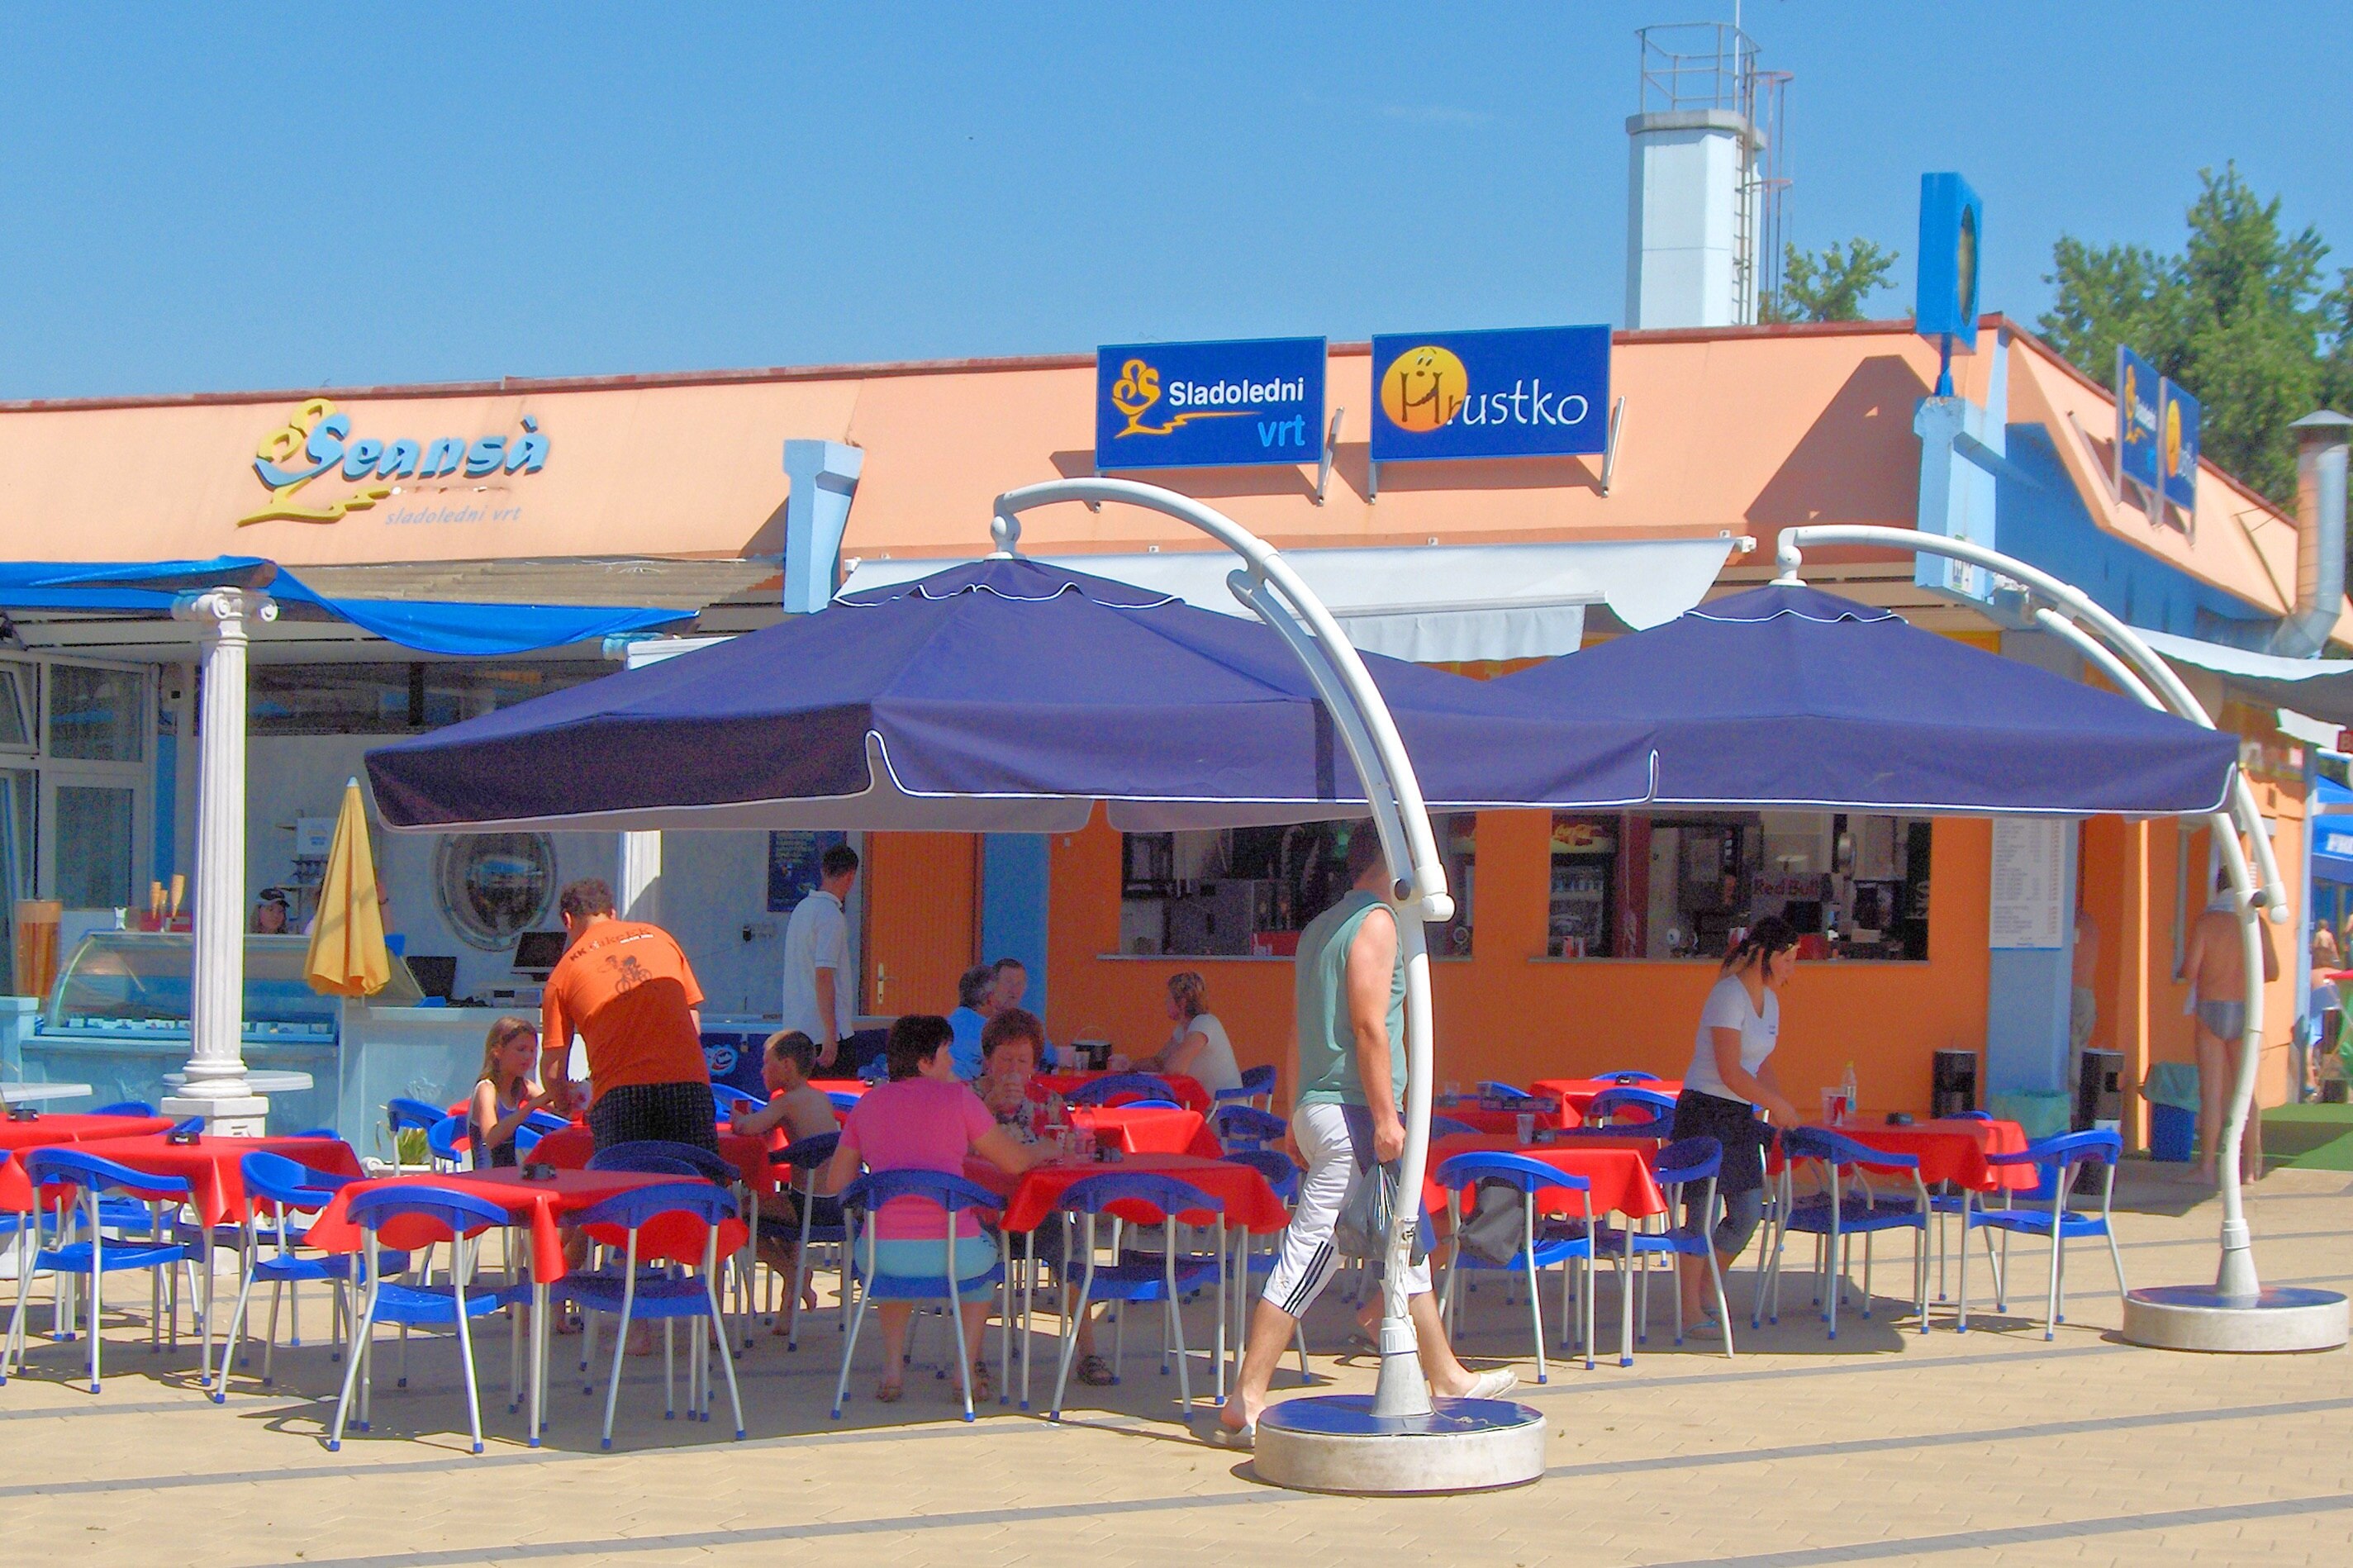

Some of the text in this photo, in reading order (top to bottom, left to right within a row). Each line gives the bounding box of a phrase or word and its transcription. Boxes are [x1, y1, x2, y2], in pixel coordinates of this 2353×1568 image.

[1168, 377, 1305, 406] Sladoledni
[1400, 371, 1589, 425] Hrustko
[1257, 414, 1305, 447] vrt
[385, 505, 522, 525] sladoledni vrt
